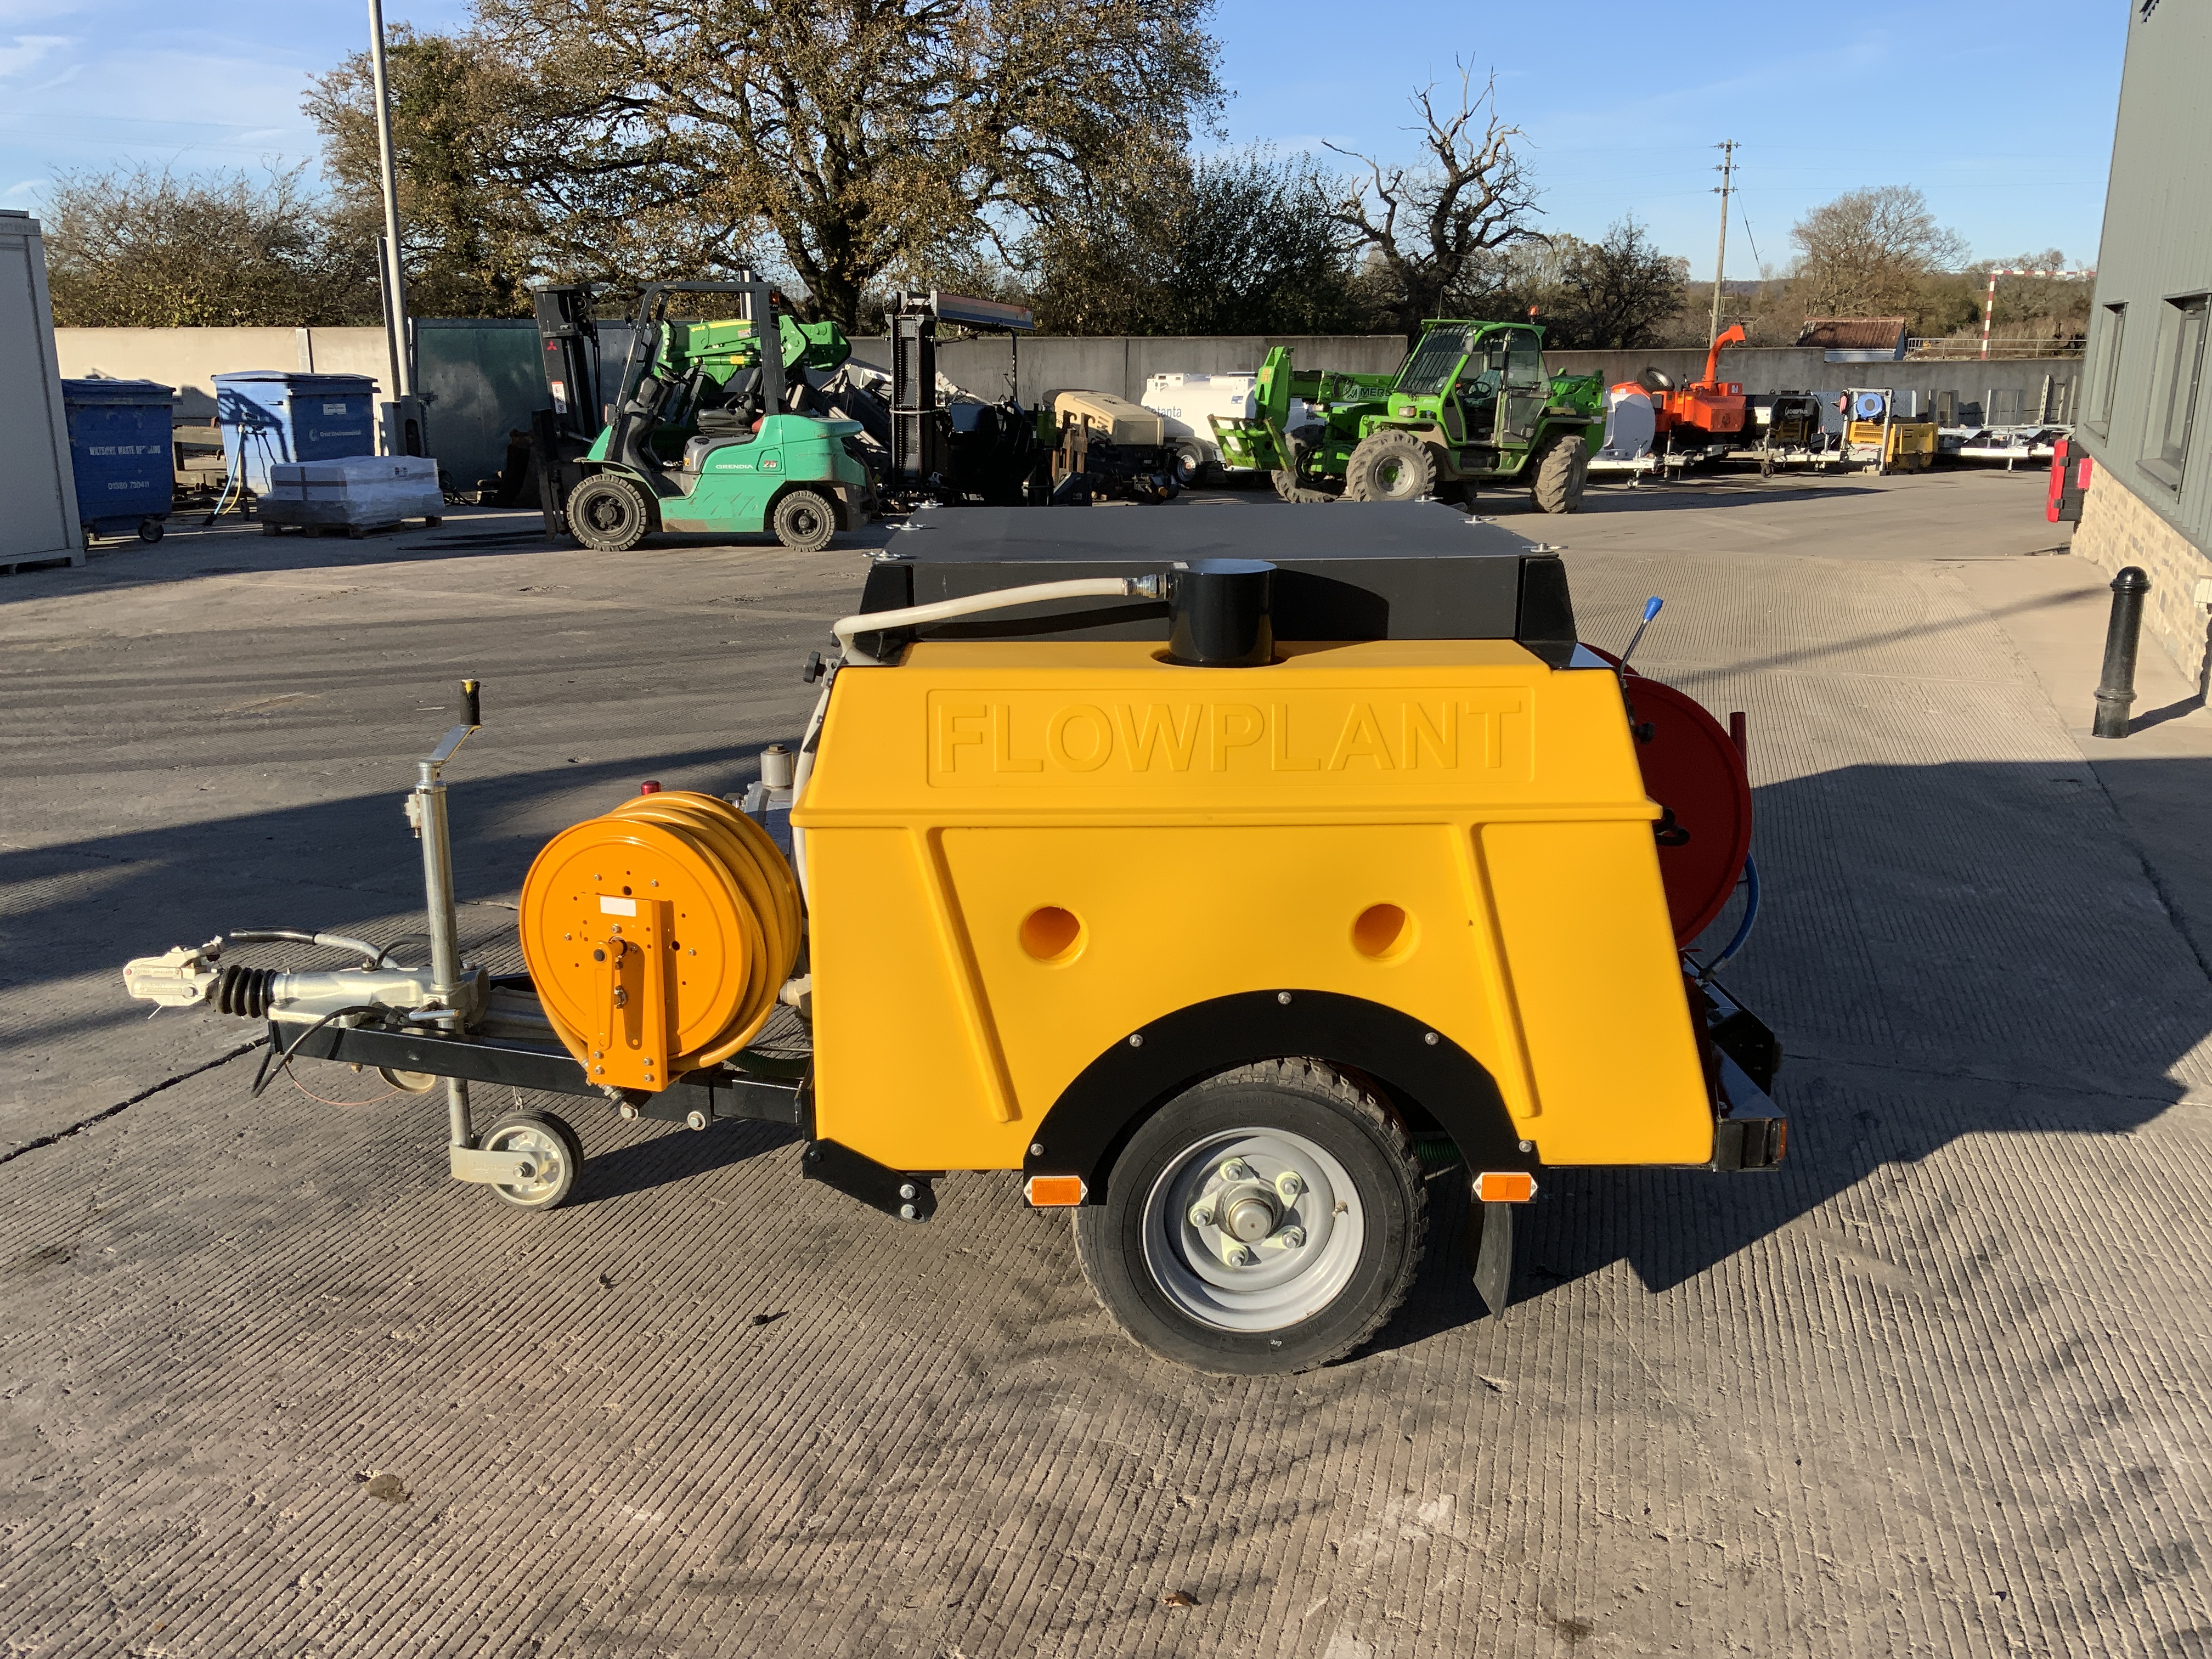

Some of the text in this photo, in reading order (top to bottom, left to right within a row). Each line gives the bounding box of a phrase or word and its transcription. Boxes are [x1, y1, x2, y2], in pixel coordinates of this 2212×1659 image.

[117, 445, 135, 455] WASTE
[763, 460, 778, 469] 25
[937, 700, 1521, 774] FLOWPLANT
